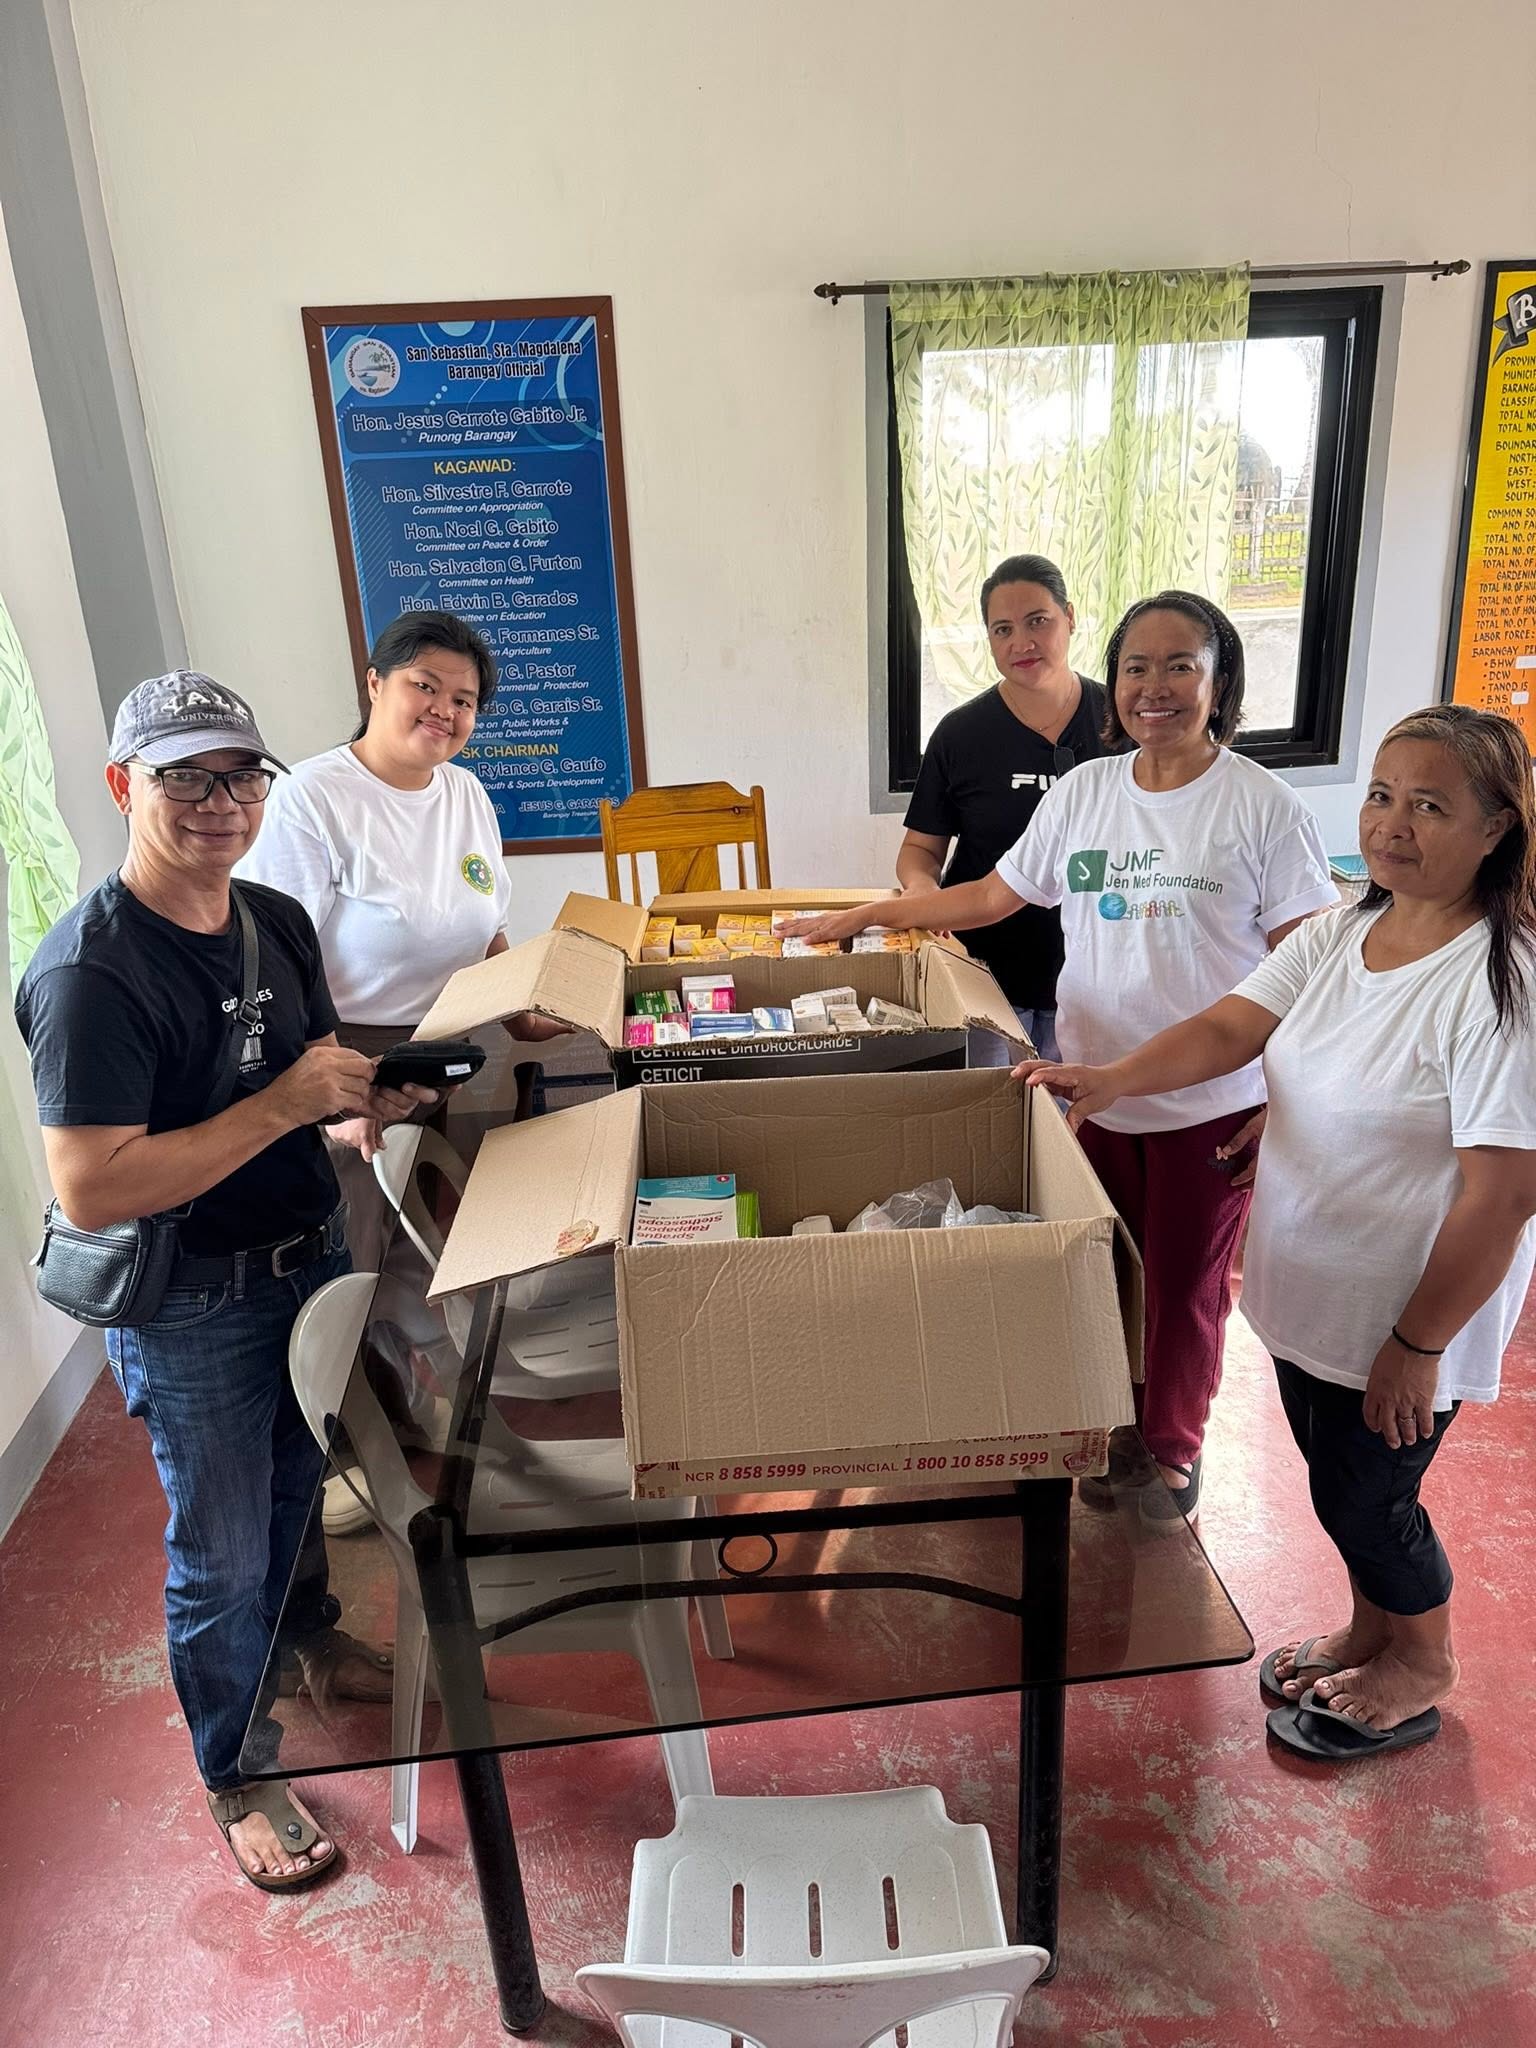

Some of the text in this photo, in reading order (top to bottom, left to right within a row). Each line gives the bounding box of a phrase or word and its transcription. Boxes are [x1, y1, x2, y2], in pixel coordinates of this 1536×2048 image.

[1514, 293, 1536, 329] B
[407, 341, 581, 361] San Sebastian, Sta. Magdalena
[449, 361, 545, 380] Barangay Official
[353, 405, 587, 431] Hon. Jesus Garrote Gabito Jr.
[1500, 410, 1524, 420] TOTAL
[1498, 423, 1522, 433] TOTAL
[419, 430, 517, 444] Punong Barangay
[434, 459, 516, 474] KAGAWAD:
[1507, 466, 1533, 477] EAST:
[382, 480, 572, 502] Hon. Silvestre F. Garrote
[412, 501, 543, 515] Committee on Appropriation
[1487, 508, 1522, 519] COMMON
[404, 517, 558, 539] Hon. Noel G. Gabito
[1502, 521, 1520, 530] AND
[415, 538, 550, 552] Committee on Peace & Order
[1485, 533, 1509, 544] TOTAL
[1512, 533, 1525, 543] NO.
[1484, 546, 1509, 556] TOTAL
[1512, 546, 1525, 556] NO.
[388, 555, 582, 577] Hon. Salvacion G. Furton
[1483, 557, 1534, 569] TOTAL NO. OF
[438, 575, 534, 588] Committee on Health
[1480, 582, 1500, 592] TOTAL
[1503, 581, 1513, 592] NO.
[1515, 581, 1522, 592] OF
[400, 590, 577, 613] Hon. Edwin B. Garados
[1479, 595, 1500, 606] TOTAL
[1503, 595, 1513, 605] NO.
[1515, 594, 1523, 605] OF
[500, 611, 546, 621] Education
[1477, 608, 1498, 618] TOTAL
[1500, 607, 1511, 617] NO.
[1512, 606, 1521, 616] OF
[1476, 620, 1499, 630] TOTAL
[1503, 618, 1516, 628] NO.
[499, 627, 575, 643] Formanes
[578, 624, 600, 640] Sr.
[1473, 629, 1535, 642] LABOR FORCE:
[502, 646, 552, 657] Agriculture
[1472, 646, 1519, 657] BARANGAY
[1489, 658, 1514, 669] BHW
[506, 664, 524, 680] G.
[526, 663, 576, 679] Pastor
[1489, 671, 1511, 681] DCW
[543, 681, 589, 691] Protection
[1488, 682, 1519, 692] TANOD
[510, 699, 528, 715] G.
[530, 697, 579, 713] Garais
[581, 696, 603, 711] Sr.
[1486, 694, 1508, 705] BNS
[180, 712, 244, 724] UNIVERSITY
[502, 719, 530, 729] Public
[532, 718, 560, 727] Works
[562, 717, 569, 725] &
[505, 727, 564, 740] Development
[462, 744, 559, 759] SK CHAIRMAN
[479, 762, 538, 780] Rylance
[541, 759, 558, 774] G.
[507, 781, 514, 789] &
[515, 780, 548, 791] Sports
[547, 777, 604, 790] Development
[519, 801, 553, 812] JESUS
[554, 800, 566, 810] G.
[567, 797, 620, 809] GARAS
[1110, 848, 1164, 872] JMF
[1105, 872, 1224, 895] Jen Med Foundation
[641, 1066, 703, 1083] CETICIT
[638, 1213, 724, 1226] Stethoscope
[637, 1224, 711, 1233] Rappaport
[637, 1232, 695, 1240] Sprague
[685, 1451, 1049, 1482] NCR 8 858 5999 PROVINCIAL 1 800 10 858 5999
